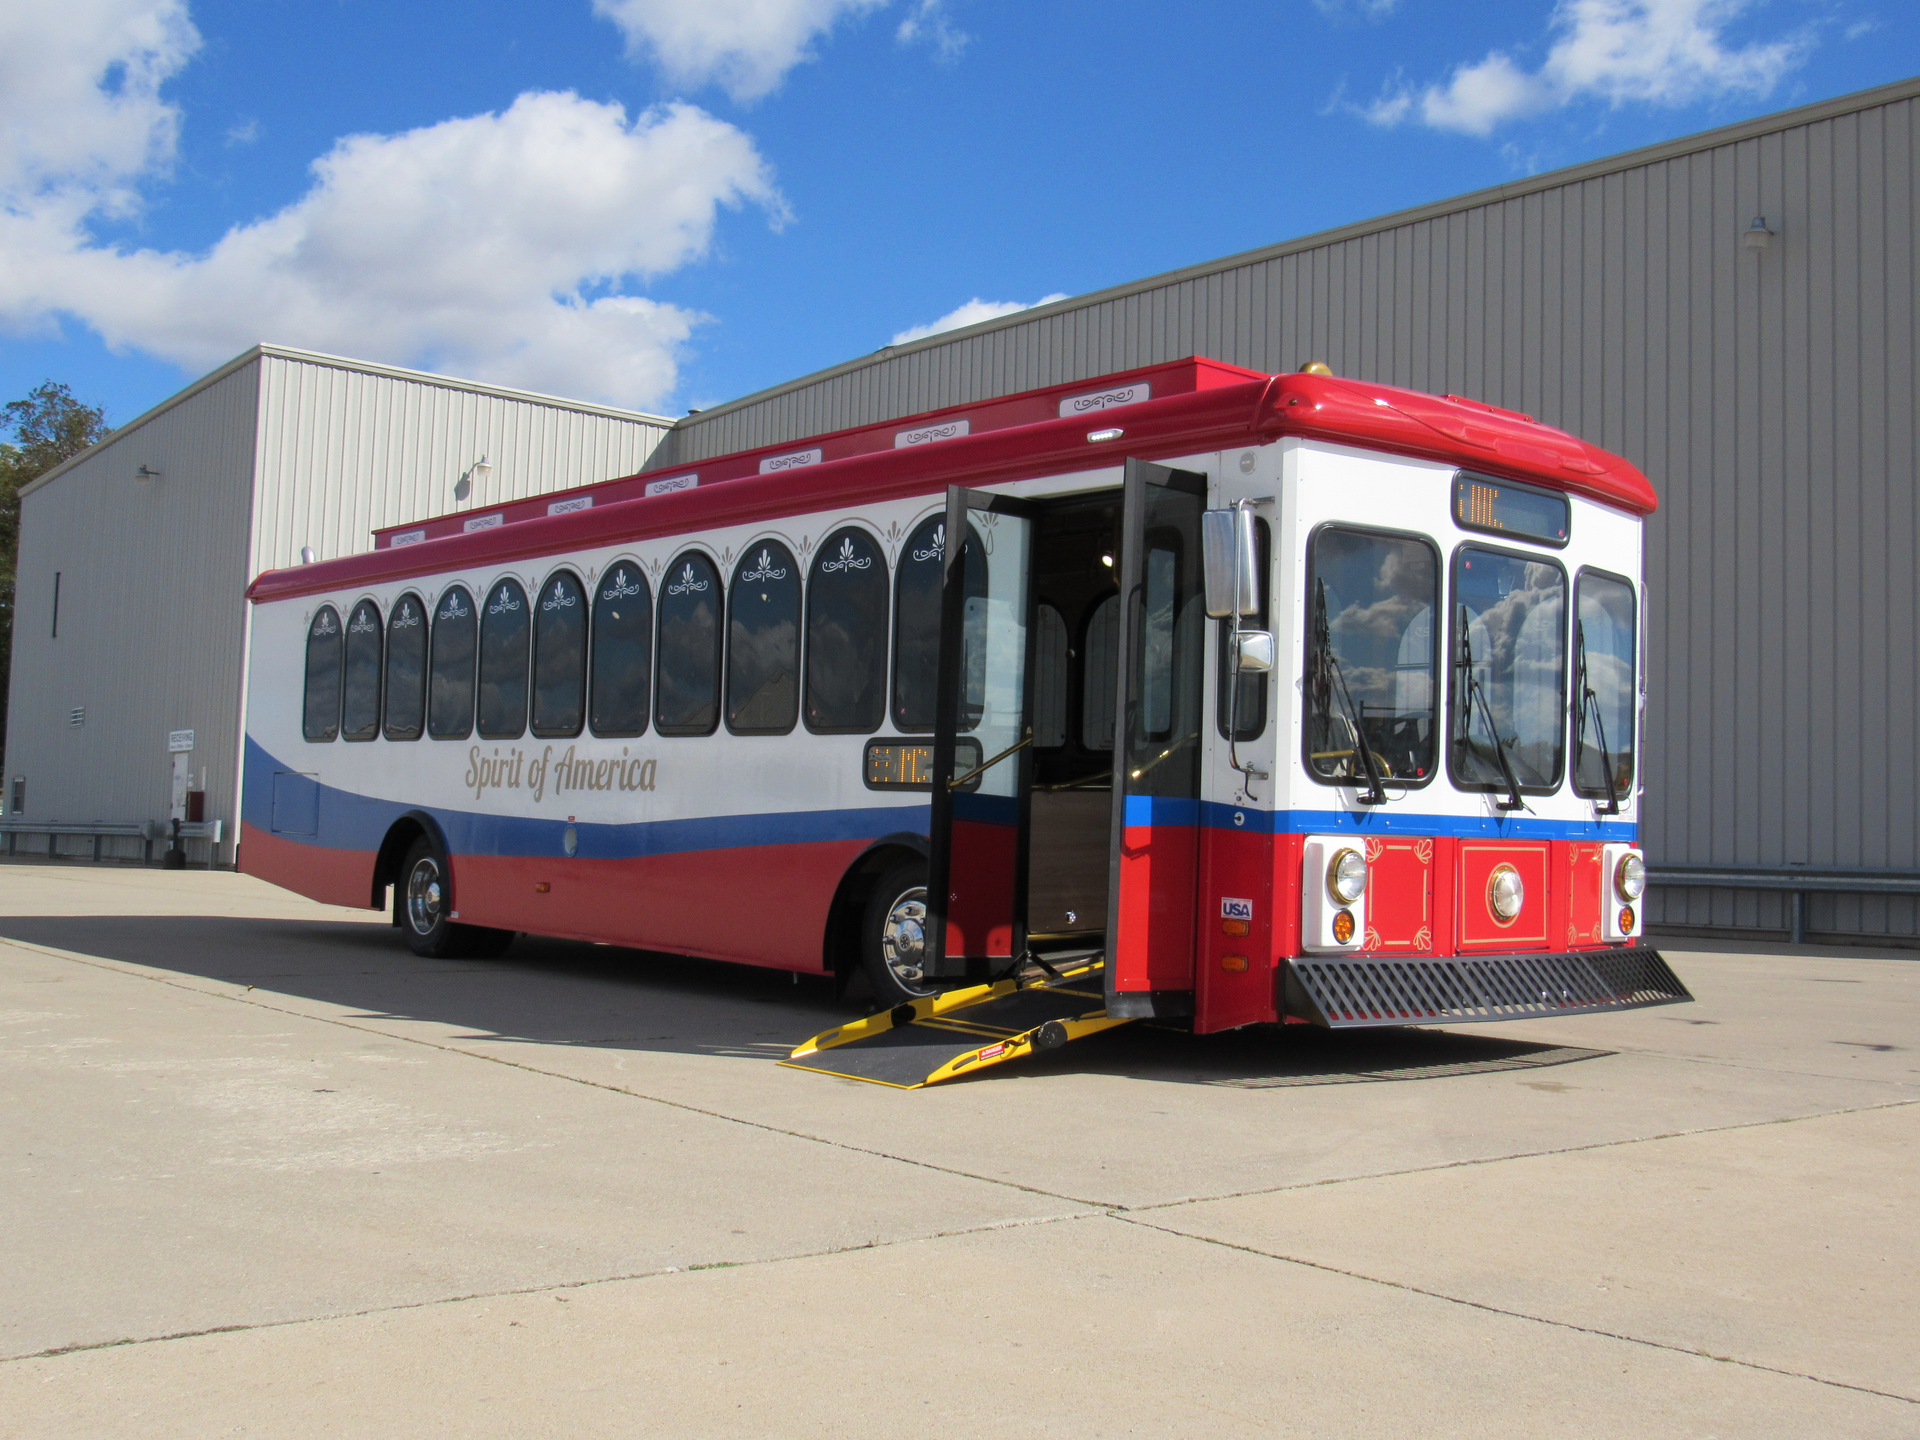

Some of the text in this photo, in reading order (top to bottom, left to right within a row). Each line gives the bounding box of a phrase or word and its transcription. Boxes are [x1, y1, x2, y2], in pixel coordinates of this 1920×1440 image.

[465, 744, 658, 803] Spirit of America
[1223, 902, 1250, 917] USA
[985, 1045, 1003, 1055] DANGER
